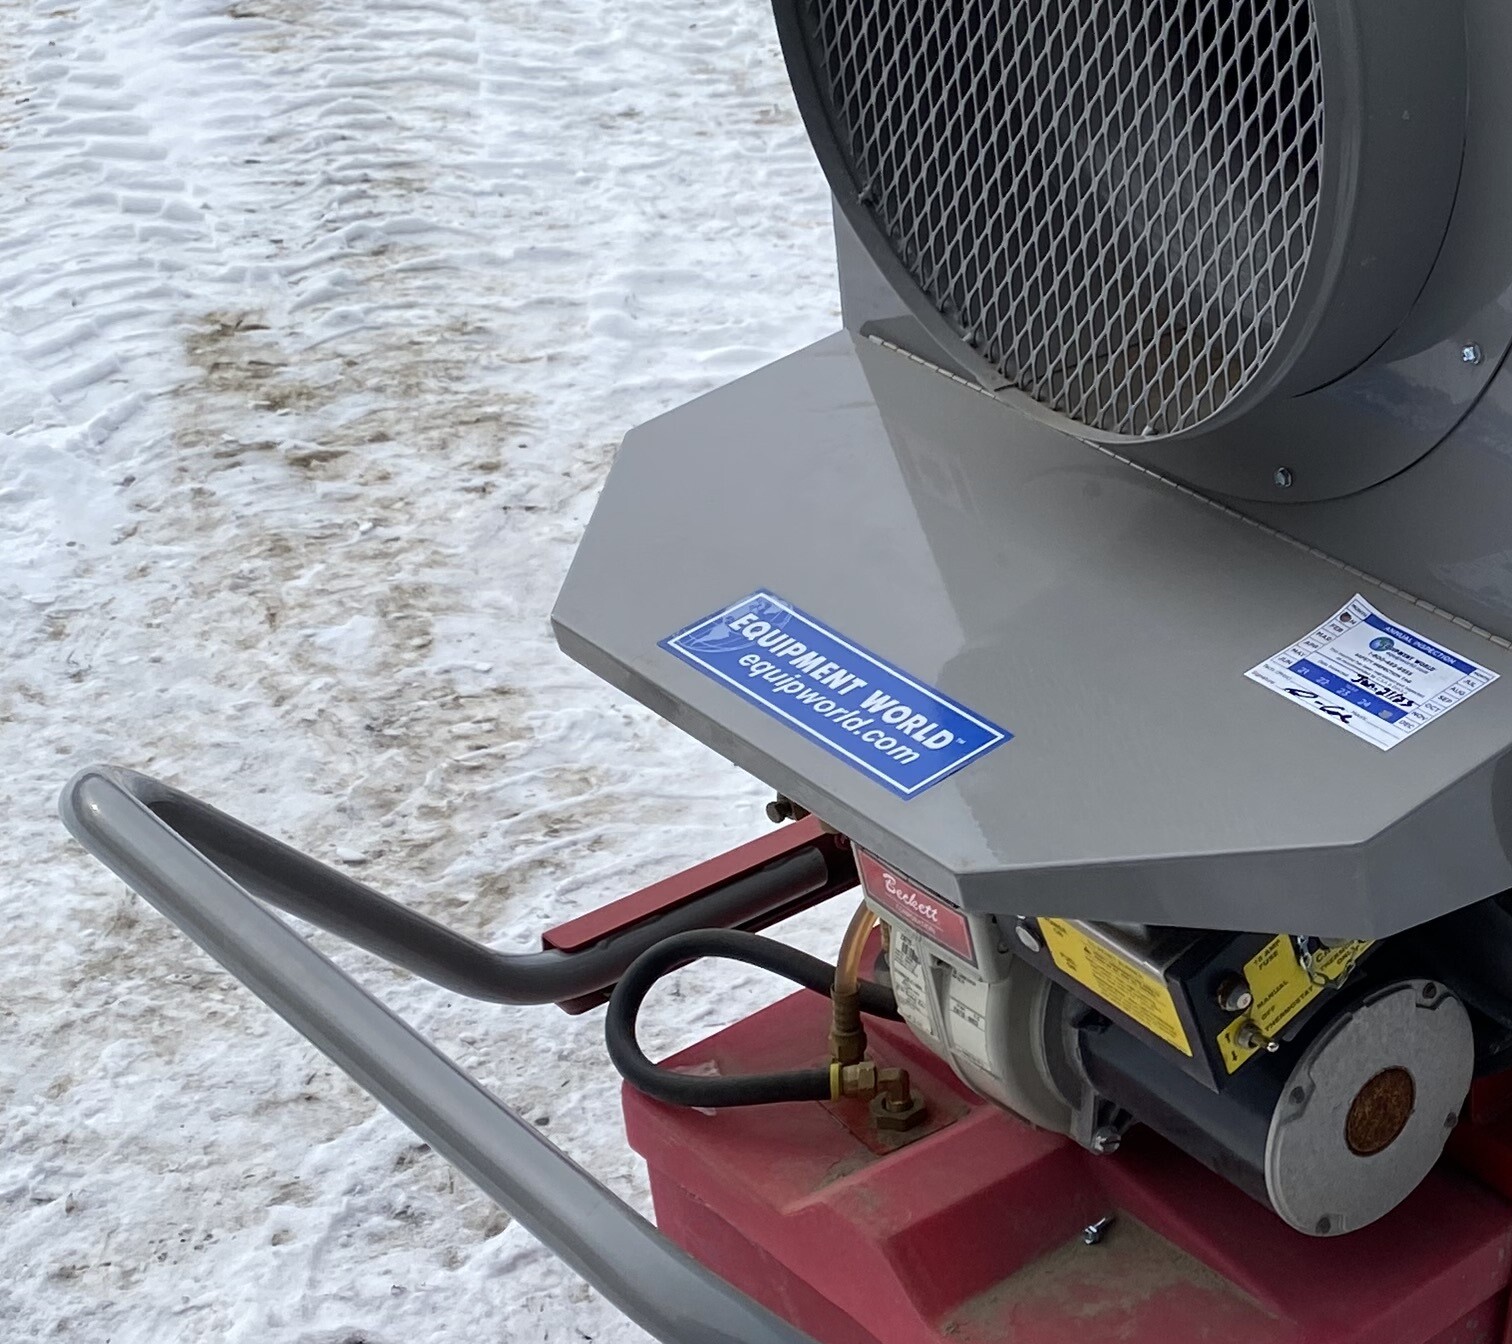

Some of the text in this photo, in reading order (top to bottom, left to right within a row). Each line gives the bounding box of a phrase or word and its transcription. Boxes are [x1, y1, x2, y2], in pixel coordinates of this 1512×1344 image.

[1316, 631, 1332, 640] MAR
[1383, 625, 1455, 664] ANNUAL INSPECTION
[1278, 656, 1293, 664] JUN
[1415, 660, 1435, 671] WORLD
[729, 613, 868, 696] EQUIPMENT
[859, 690, 954, 750] WORLD
[1315, 676, 1330, 685] 22
[1450, 686, 1465, 695] AUG
[1437, 695, 1452, 703] SEP
[738, 653, 920, 766] equipworld.com
[1424, 703, 1440, 711] OCT
[1410, 711, 1427, 720] NOV
[1398, 720, 1413, 728] DEC
[883, 872, 939, 922] Beckett
[1258, 951, 1280, 971] FUSE
[1256, 980, 1289, 1010] MANUAL
[1261, 1005, 1277, 1021] OFF
[1264, 985, 1315, 1032] THERMOSTAT
